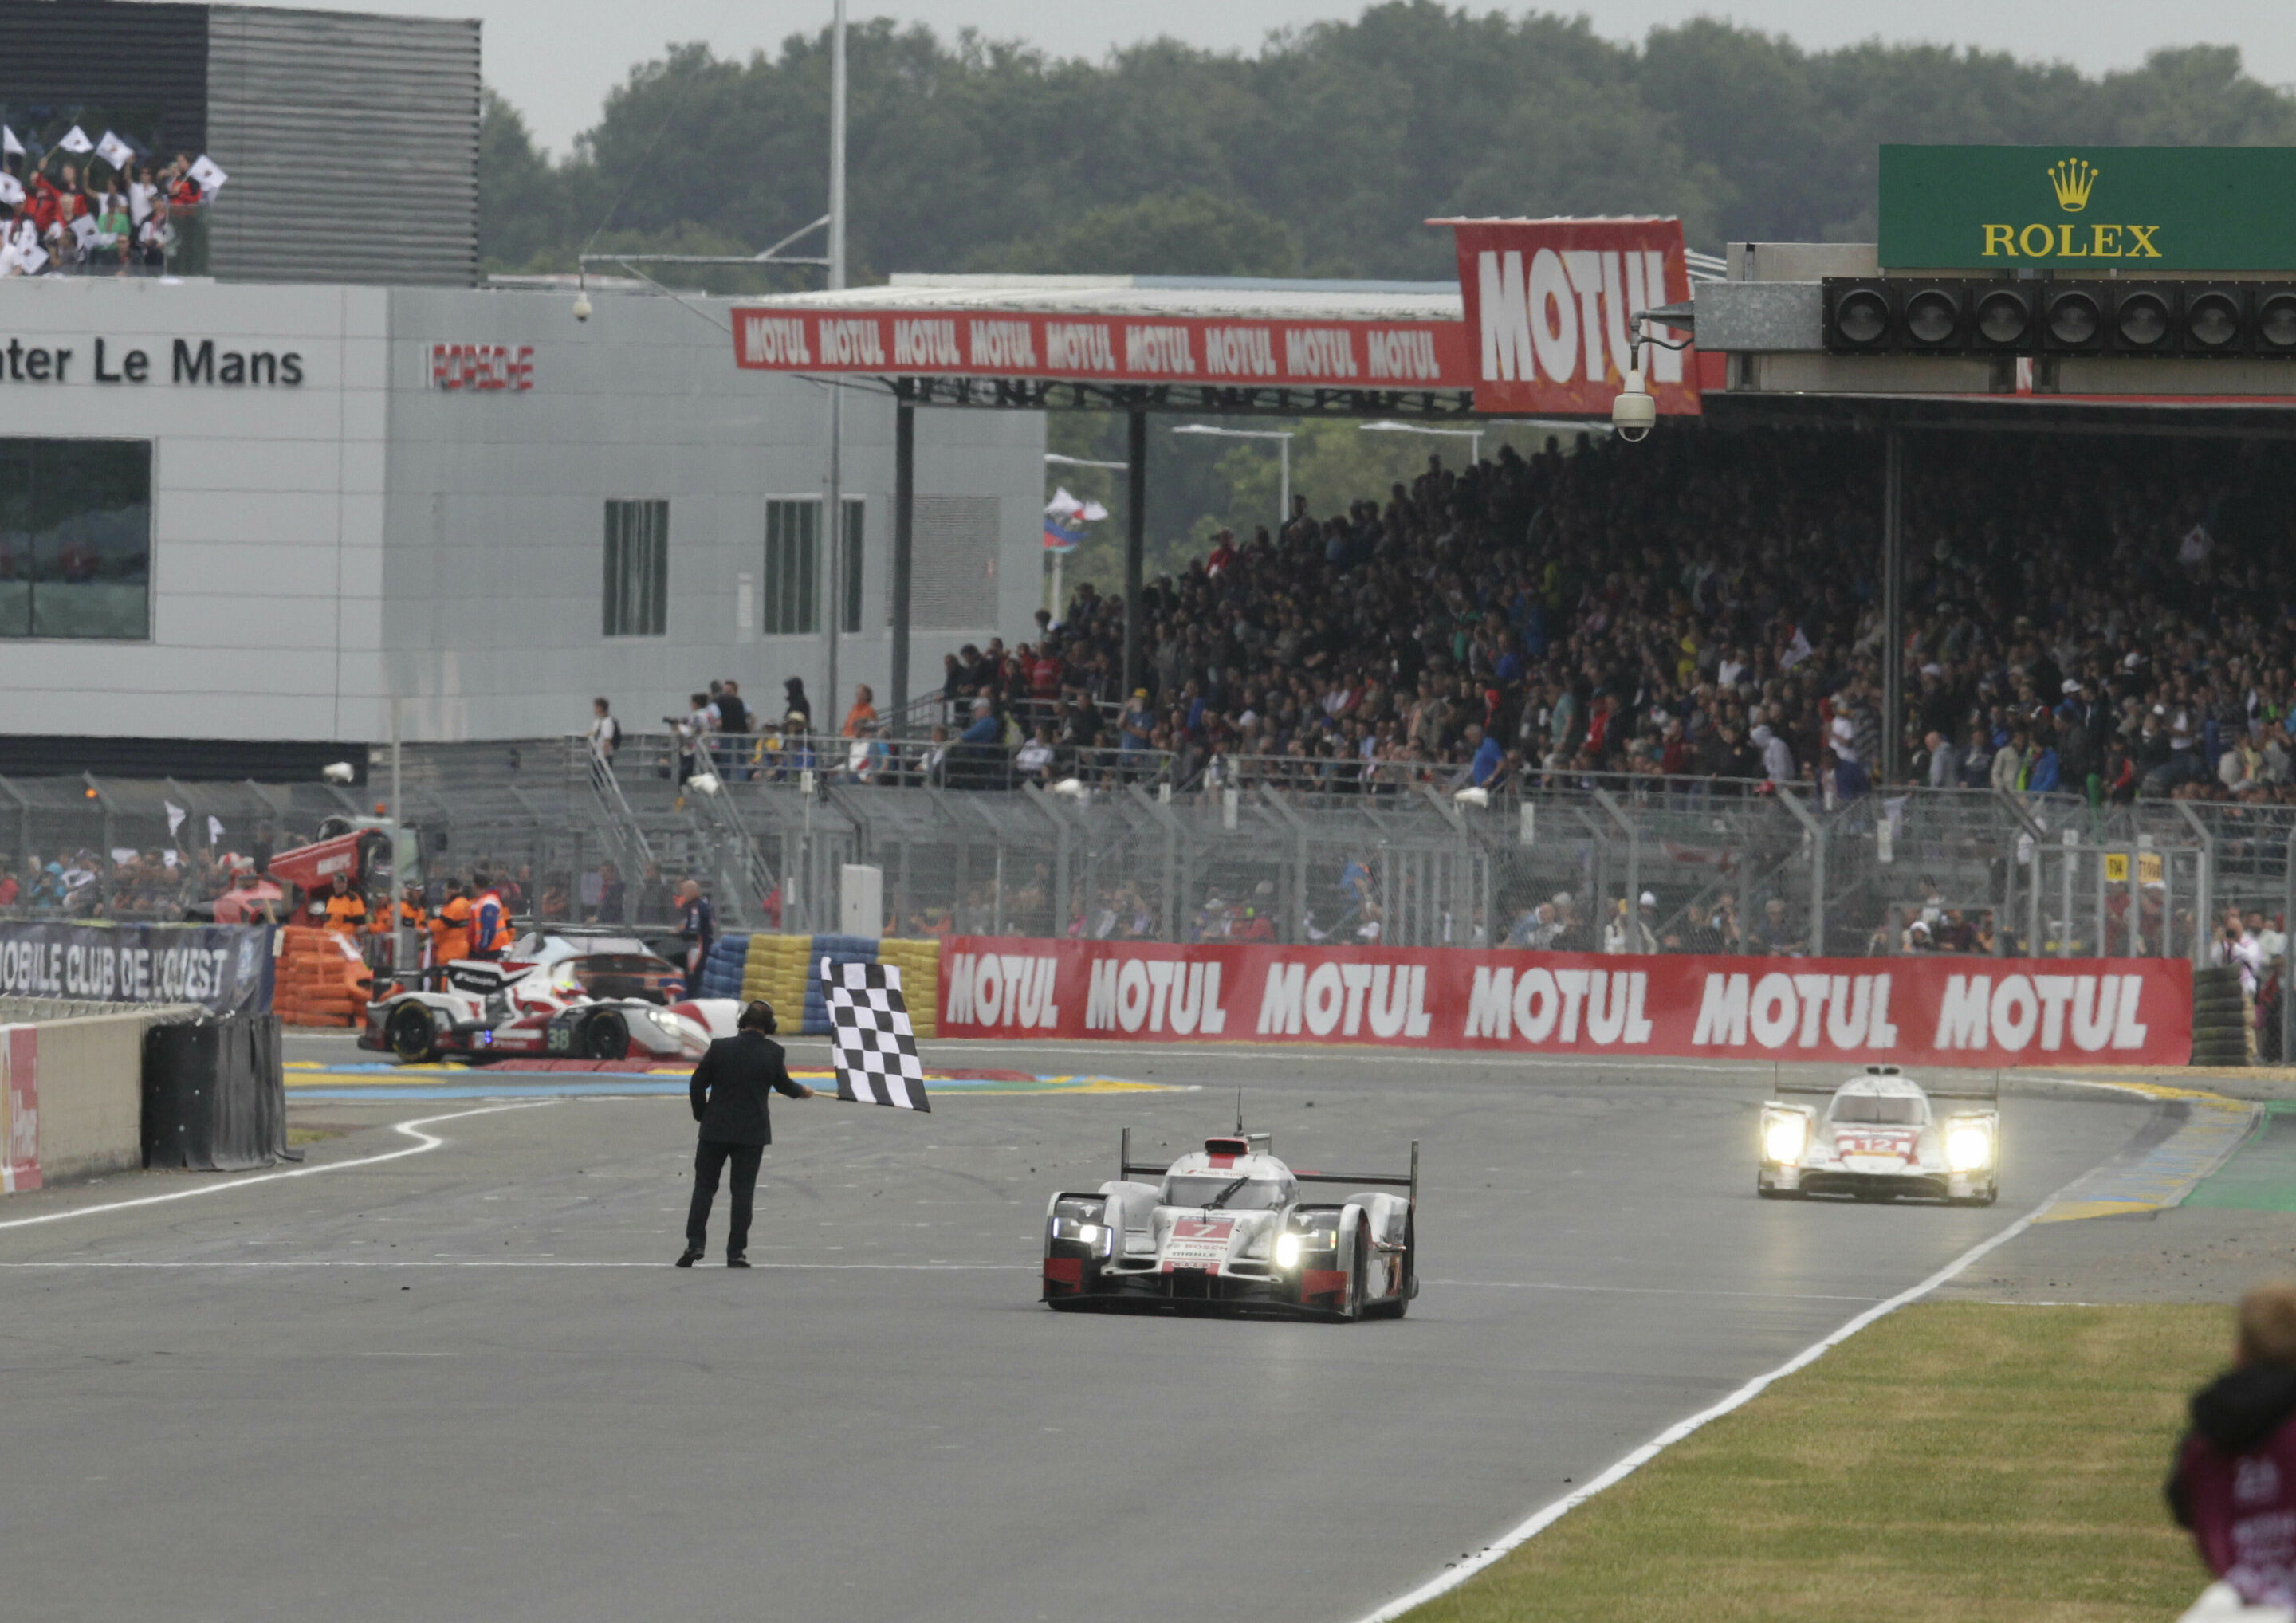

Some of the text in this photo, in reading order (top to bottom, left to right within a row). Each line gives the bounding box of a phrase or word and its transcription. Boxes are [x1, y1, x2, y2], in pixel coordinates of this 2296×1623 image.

[1981, 223, 2163, 257] ROLEX
[1478, 247, 1684, 383] MOTUL
[94, 336, 150, 383] Le
[173, 338, 303, 385] Mans
[432, 344, 534, 391] PORSCHE
[745, 316, 1440, 380] MOTUL MOTUL MOTUL MOTUL MOTUL MOTUL MOTUL MOTUL MOTUL
[0, 941, 62, 991] OBILE
[66, 944, 116, 995] CLUB
[120, 947, 149, 997] DE
[946, 953, 2147, 1053] MOTUL MOTUL MOTUL MOTUL MOTUL MOTUL
[548, 1028, 570, 1050] 38
[1860, 1138, 1893, 1152] 12
[1193, 1223, 1217, 1237] 7
